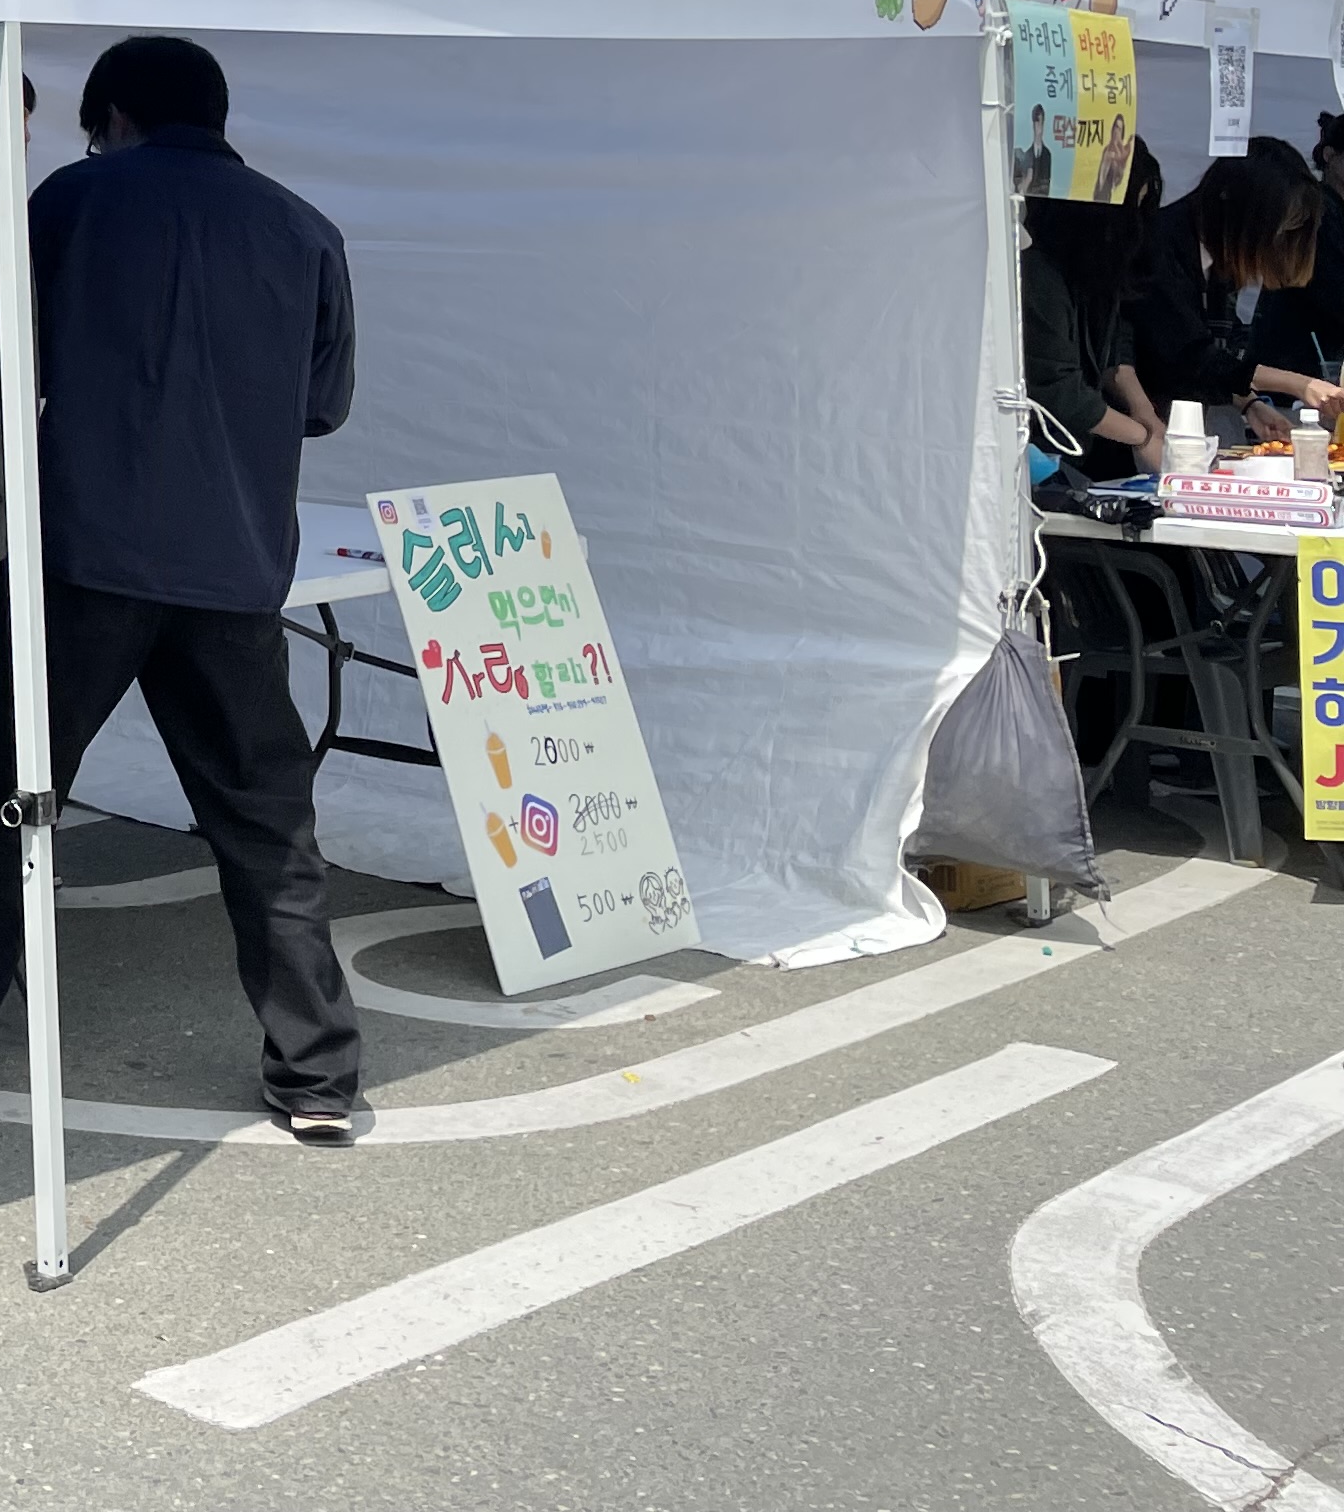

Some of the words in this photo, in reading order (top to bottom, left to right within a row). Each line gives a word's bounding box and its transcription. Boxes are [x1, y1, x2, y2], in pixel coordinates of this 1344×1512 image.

[1017, 18, 1068, 57] 바래다
[580, 827, 628, 856] 2500
[576, 889, 616, 923] 500
